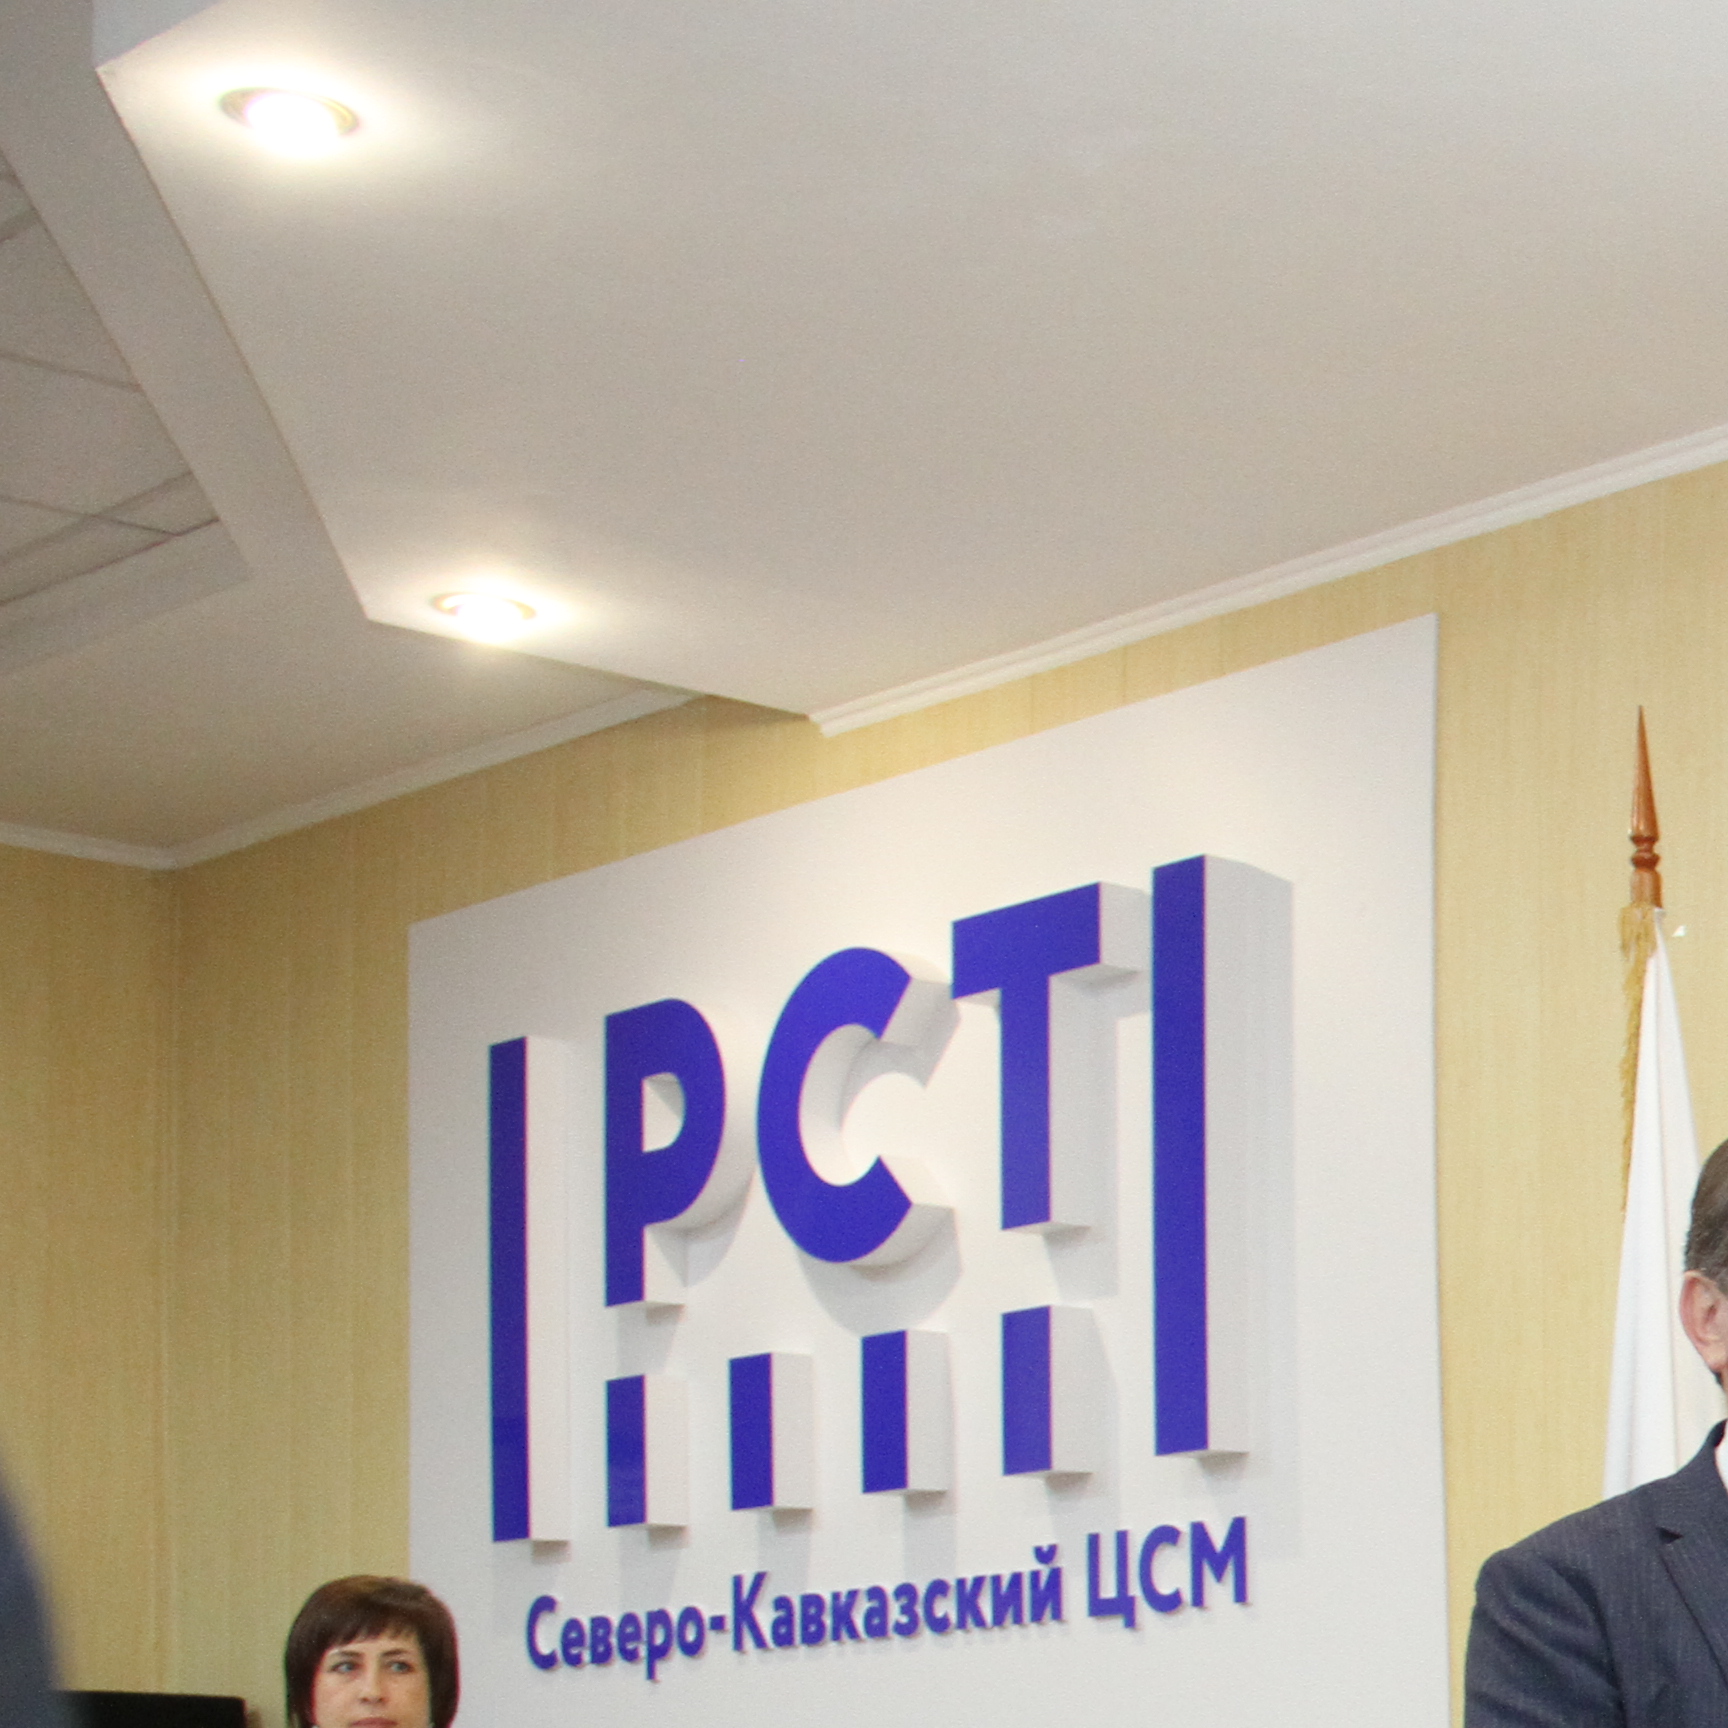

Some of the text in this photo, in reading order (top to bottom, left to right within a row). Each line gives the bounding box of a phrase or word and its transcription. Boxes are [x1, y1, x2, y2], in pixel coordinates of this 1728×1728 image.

[604, 882, 1101, 1307] РСТ
[526, 1516, 1247, 1681] Северо-Кавказский ЦСМ
